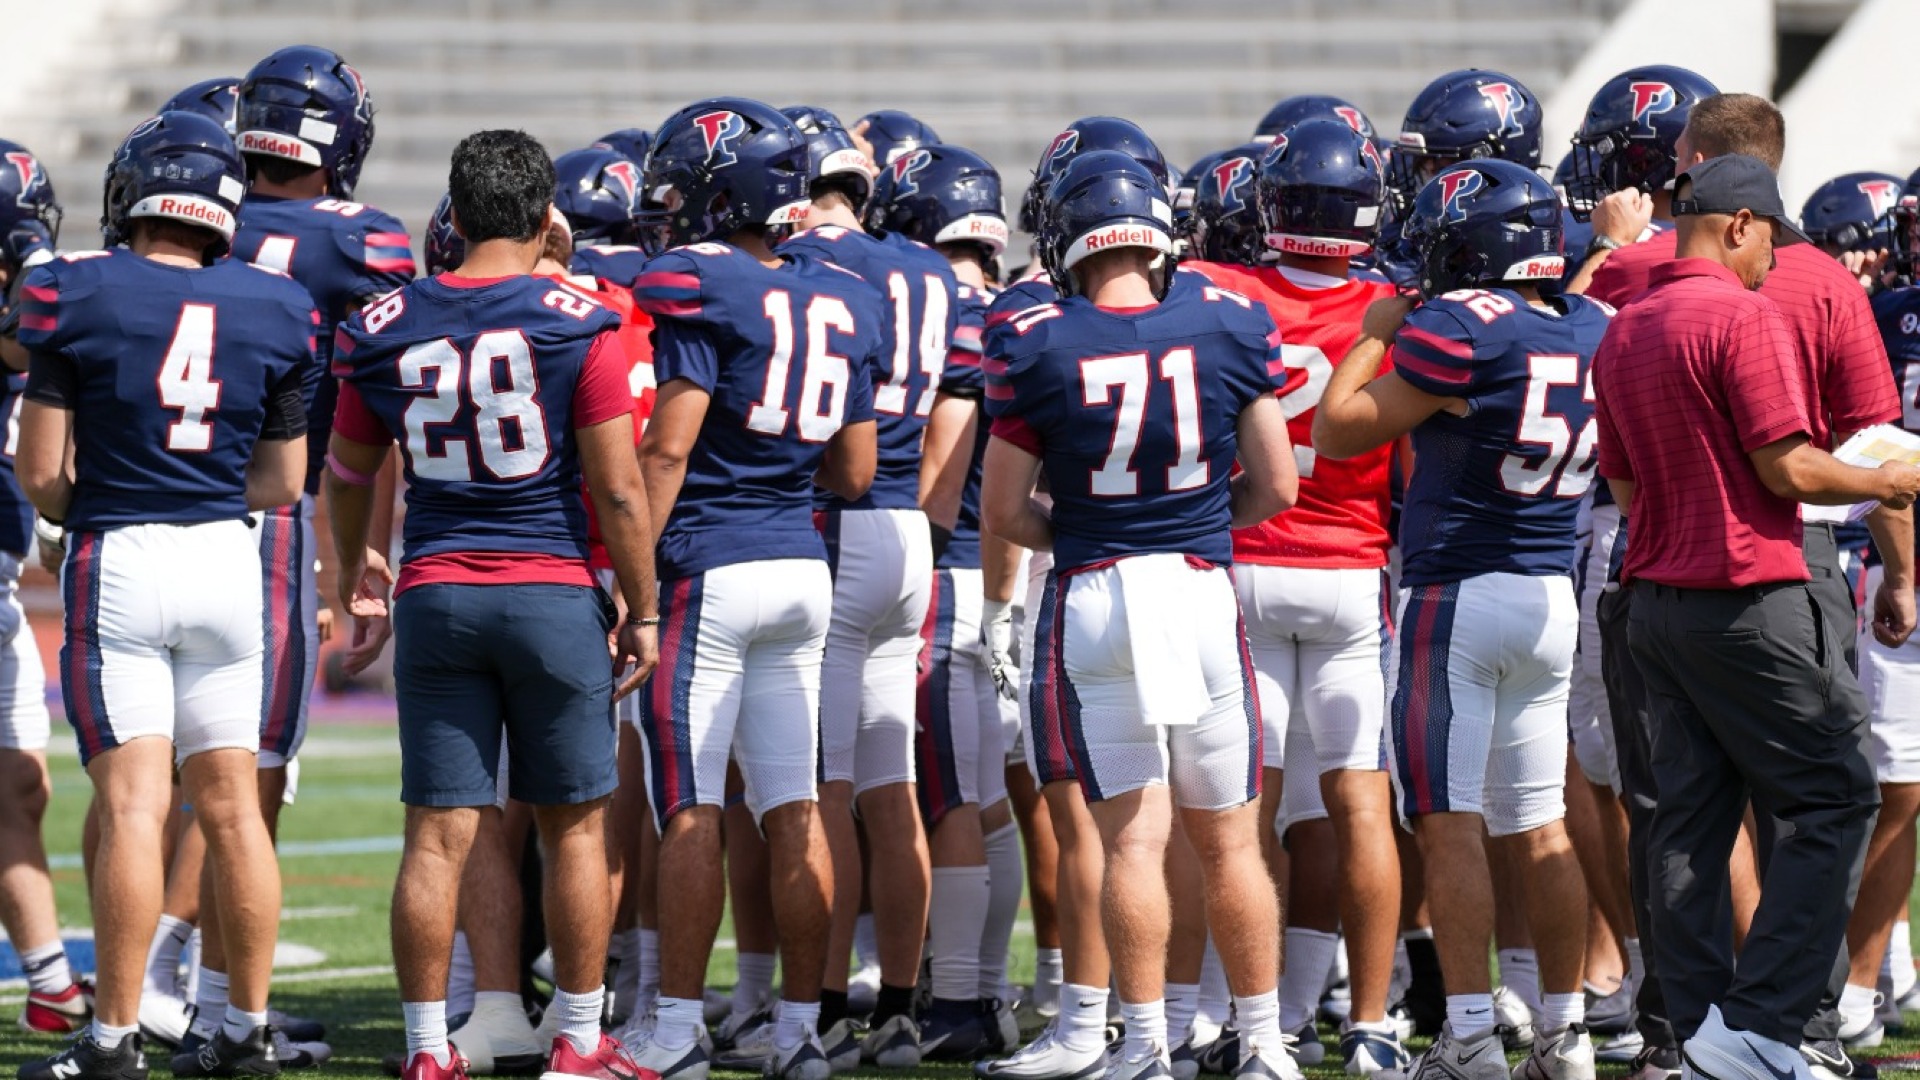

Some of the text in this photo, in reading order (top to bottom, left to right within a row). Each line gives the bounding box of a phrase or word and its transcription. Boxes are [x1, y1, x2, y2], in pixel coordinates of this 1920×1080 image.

[160, 199, 226, 226] Riddell
[244, 134, 302, 158] Riddell
[1086, 229, 1153, 250] Riddell
[1283, 238, 1349, 256] Riddell
[156, 301, 222, 452] 4
[399, 328, 551, 482] 28
[747, 289, 854, 443] 16
[873, 271, 949, 416] 14
[1079, 346, 1211, 496] 71
